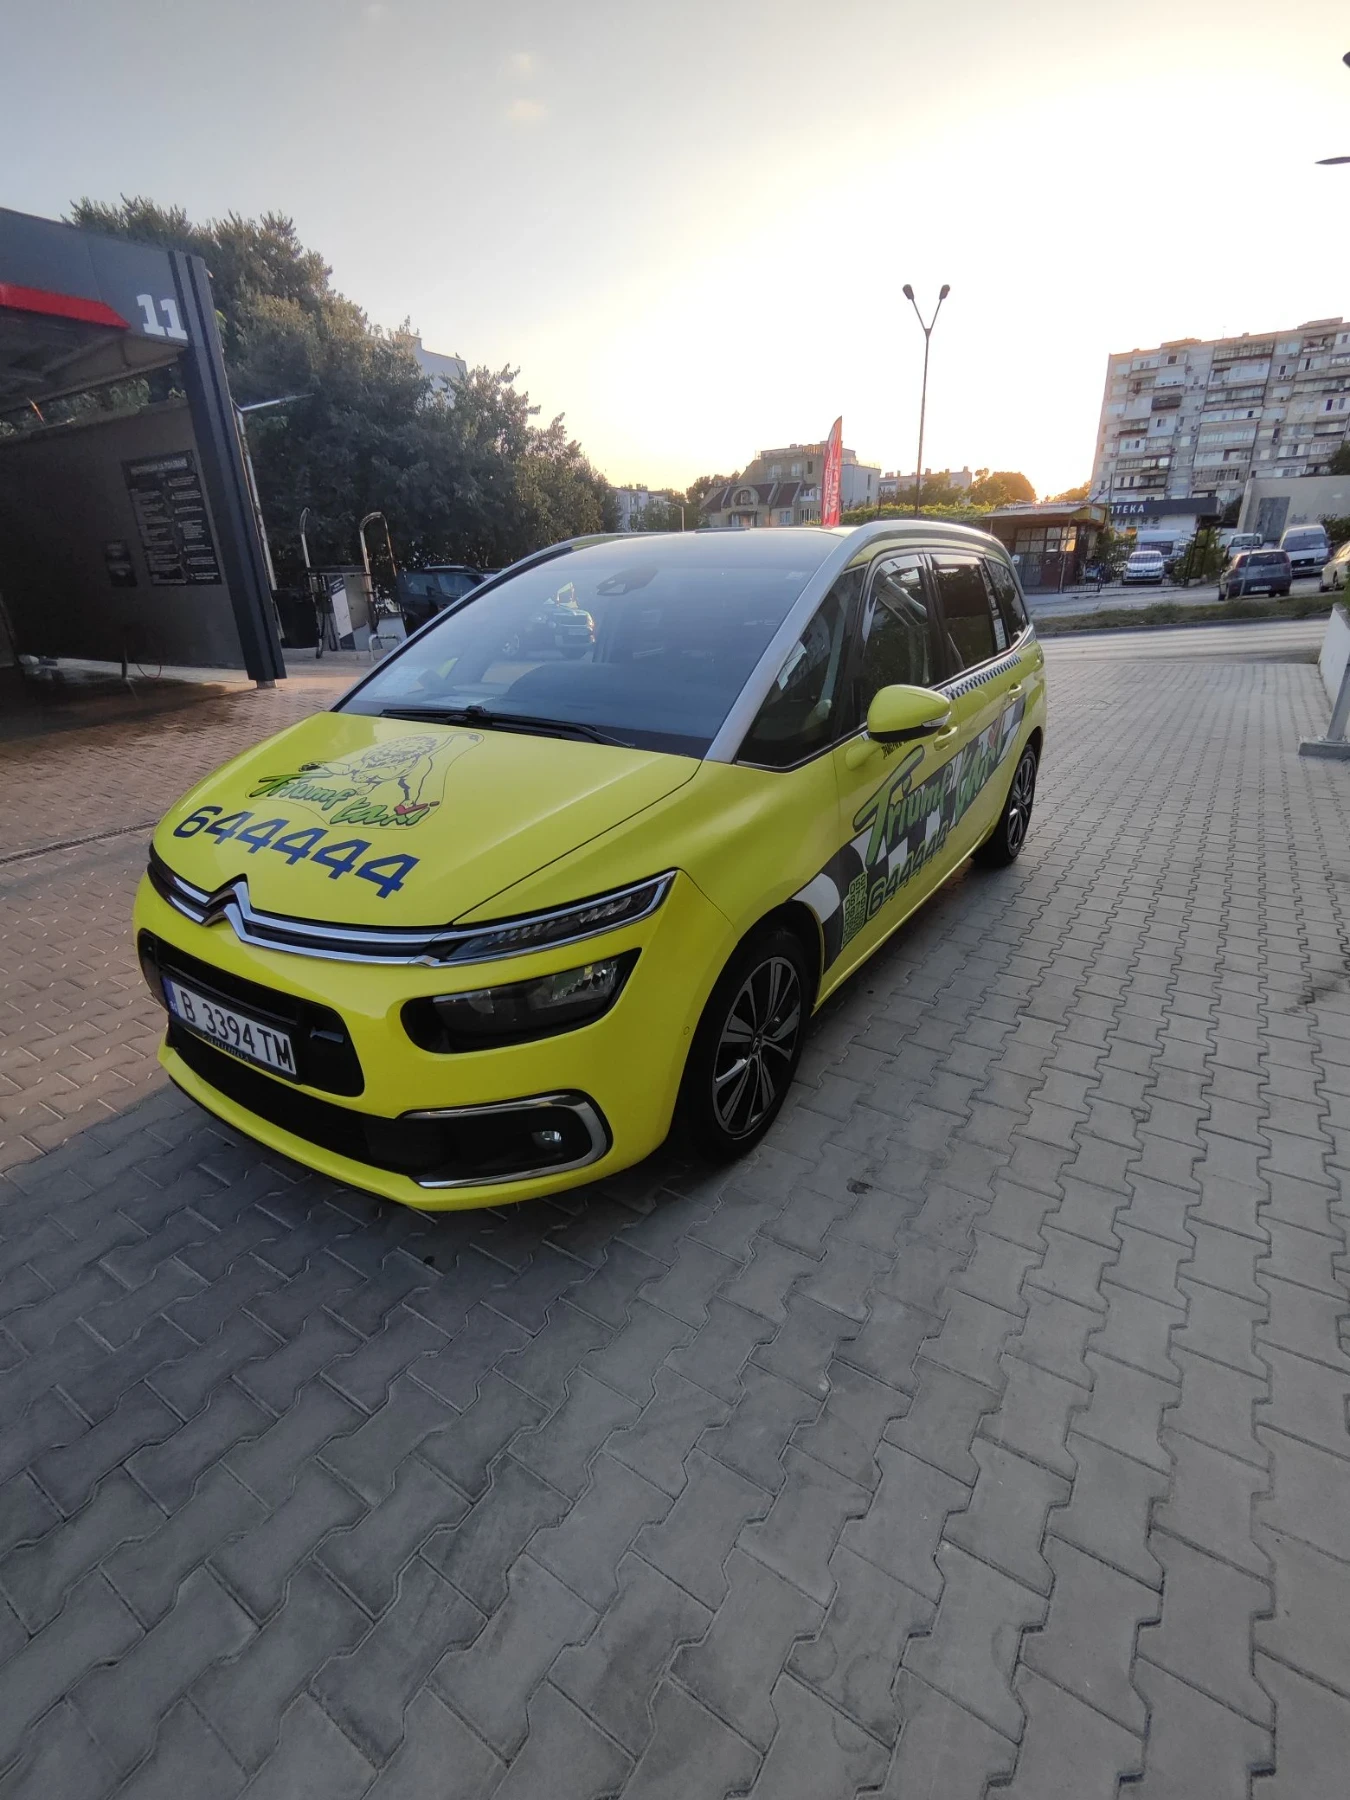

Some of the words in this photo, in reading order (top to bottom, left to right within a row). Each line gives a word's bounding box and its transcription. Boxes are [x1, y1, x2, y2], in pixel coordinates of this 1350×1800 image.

[136, 294, 188, 340] 11
[249, 773, 358, 811] Triumf
[330, 797, 440, 827] taxi
[173, 806, 420, 899] 644444
[867, 819, 949, 920] 644444
[180, 989, 196, 1022] B
[202, 1003, 255, 1055] 3394
[257, 1027, 293, 1072] TM
